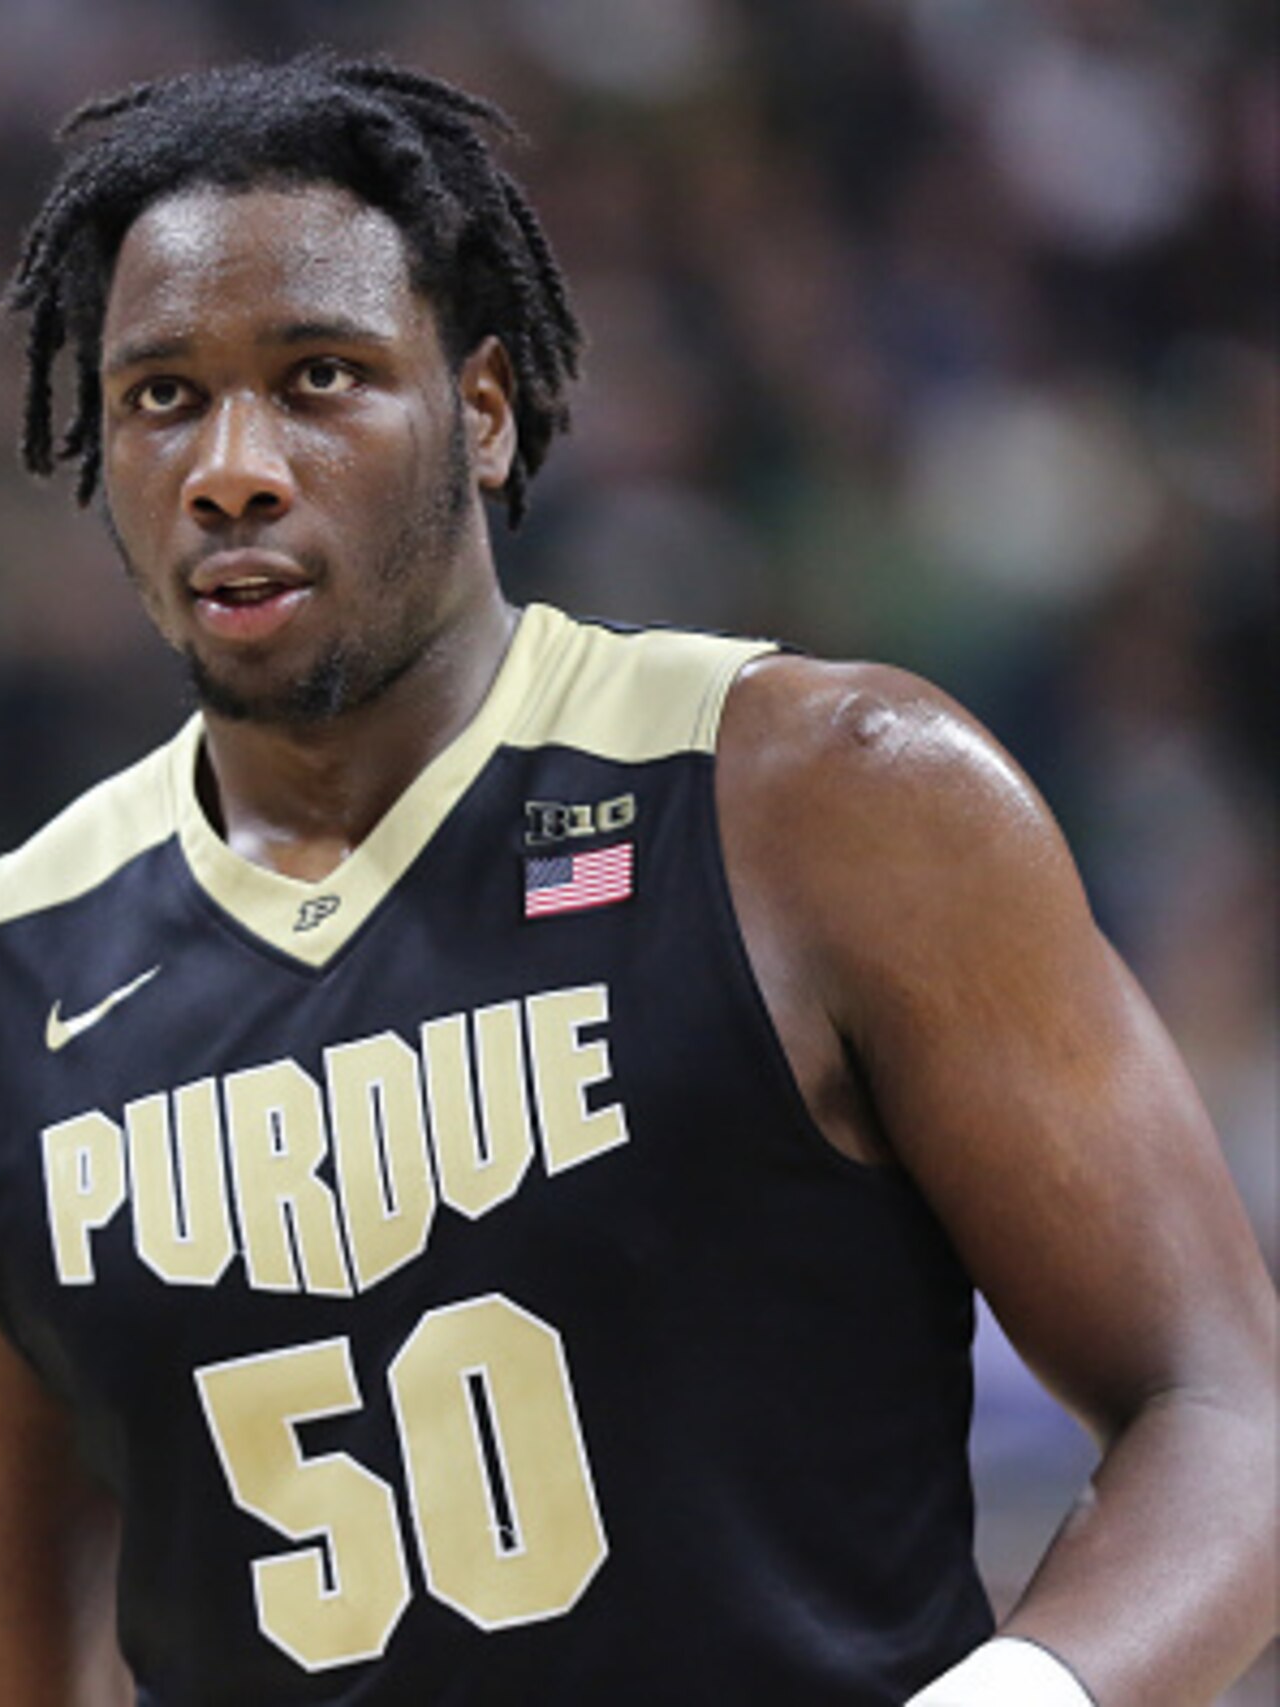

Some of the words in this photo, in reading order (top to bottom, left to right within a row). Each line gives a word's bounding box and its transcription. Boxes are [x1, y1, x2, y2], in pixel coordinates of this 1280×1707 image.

[293, 893, 341, 933] P
[41, 983, 630, 1298] PURDUE
[193, 1292, 610, 1673] 50
